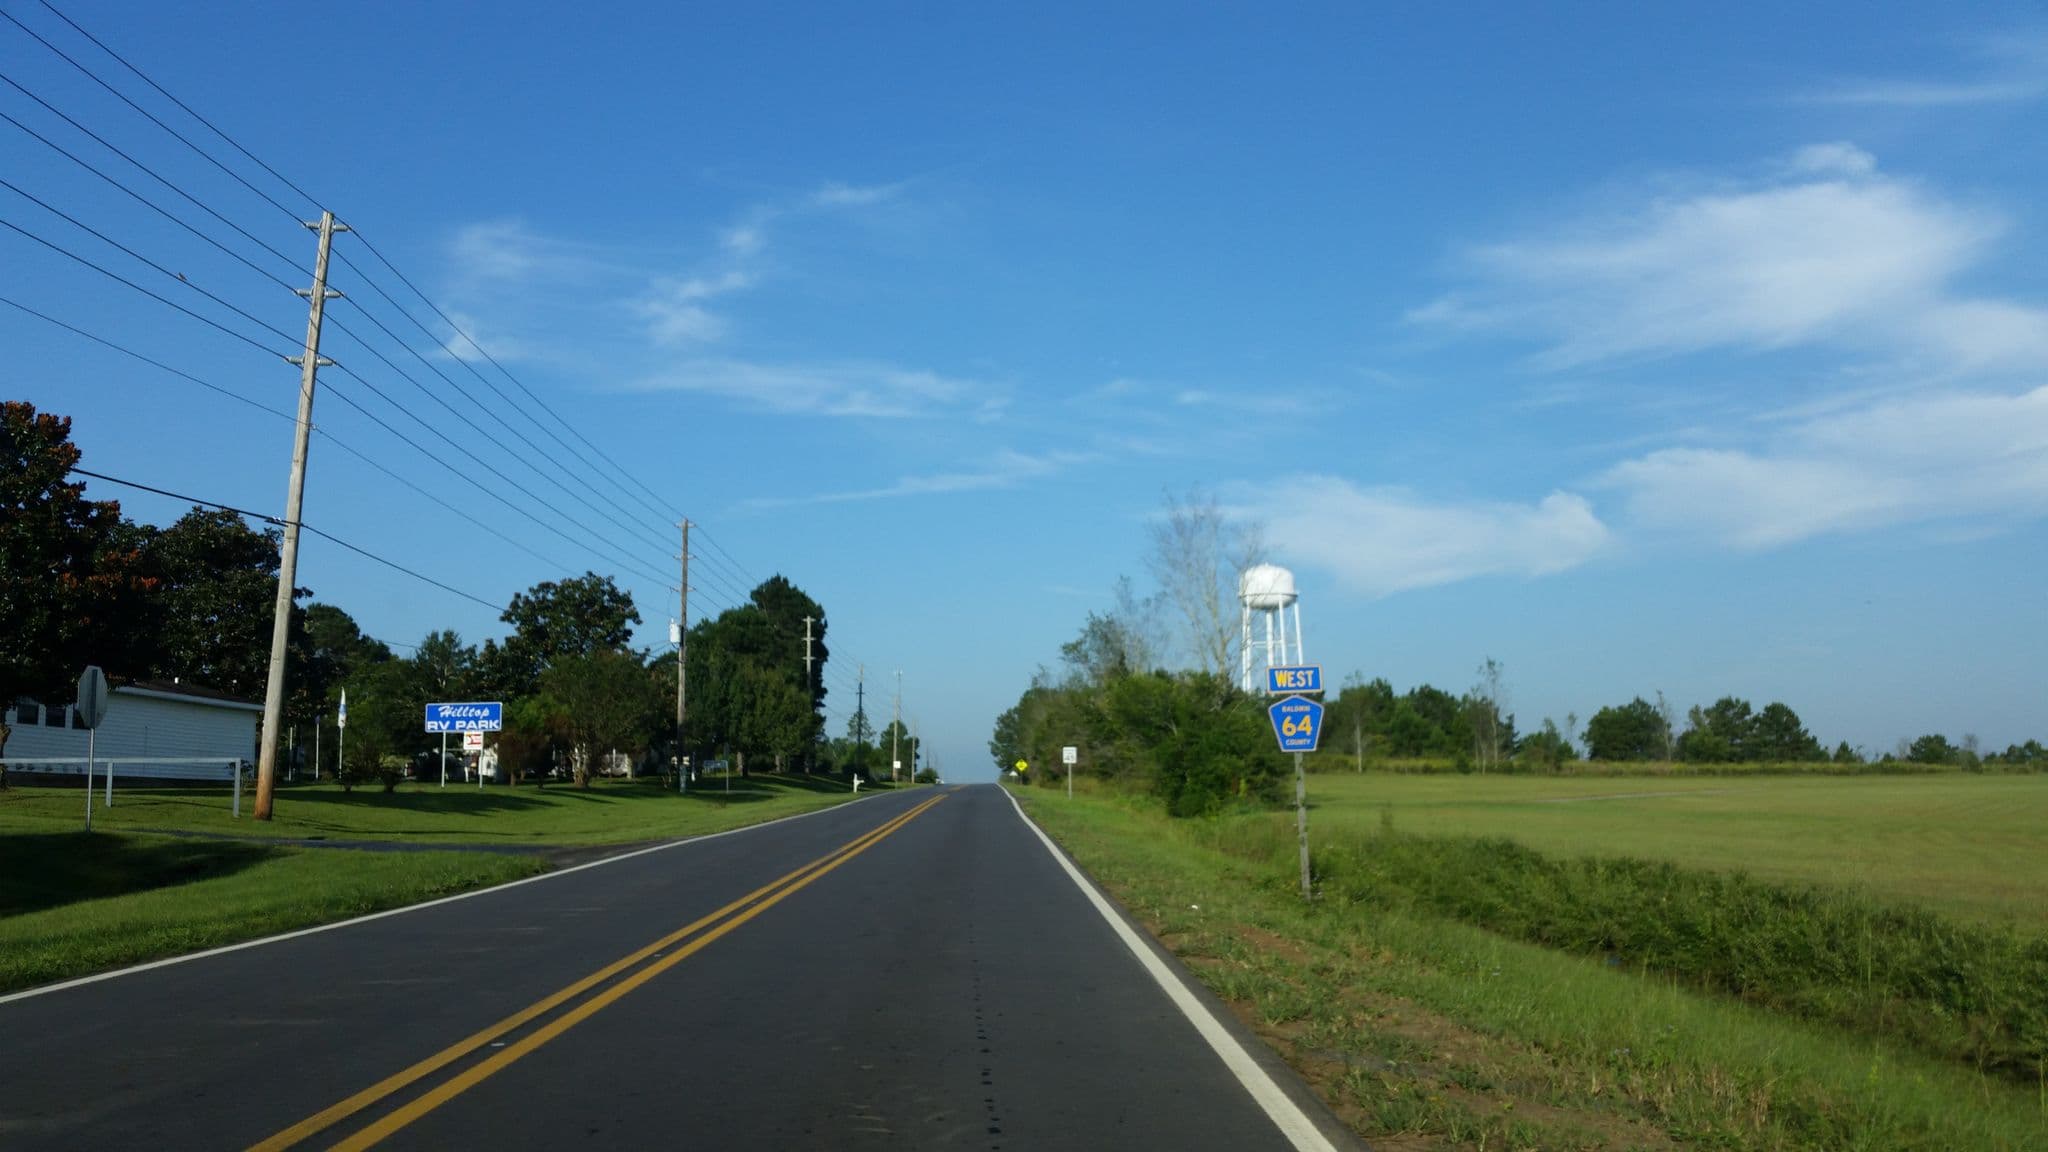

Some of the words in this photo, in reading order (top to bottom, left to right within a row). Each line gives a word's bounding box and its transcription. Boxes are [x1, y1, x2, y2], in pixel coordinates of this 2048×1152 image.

[1274, 670, 1314, 688] WEST
[438, 705, 490, 719] Hilltop
[427, 720, 450, 730] RV
[456, 720, 499, 730] PARK
[1282, 714, 1312, 737] 64
